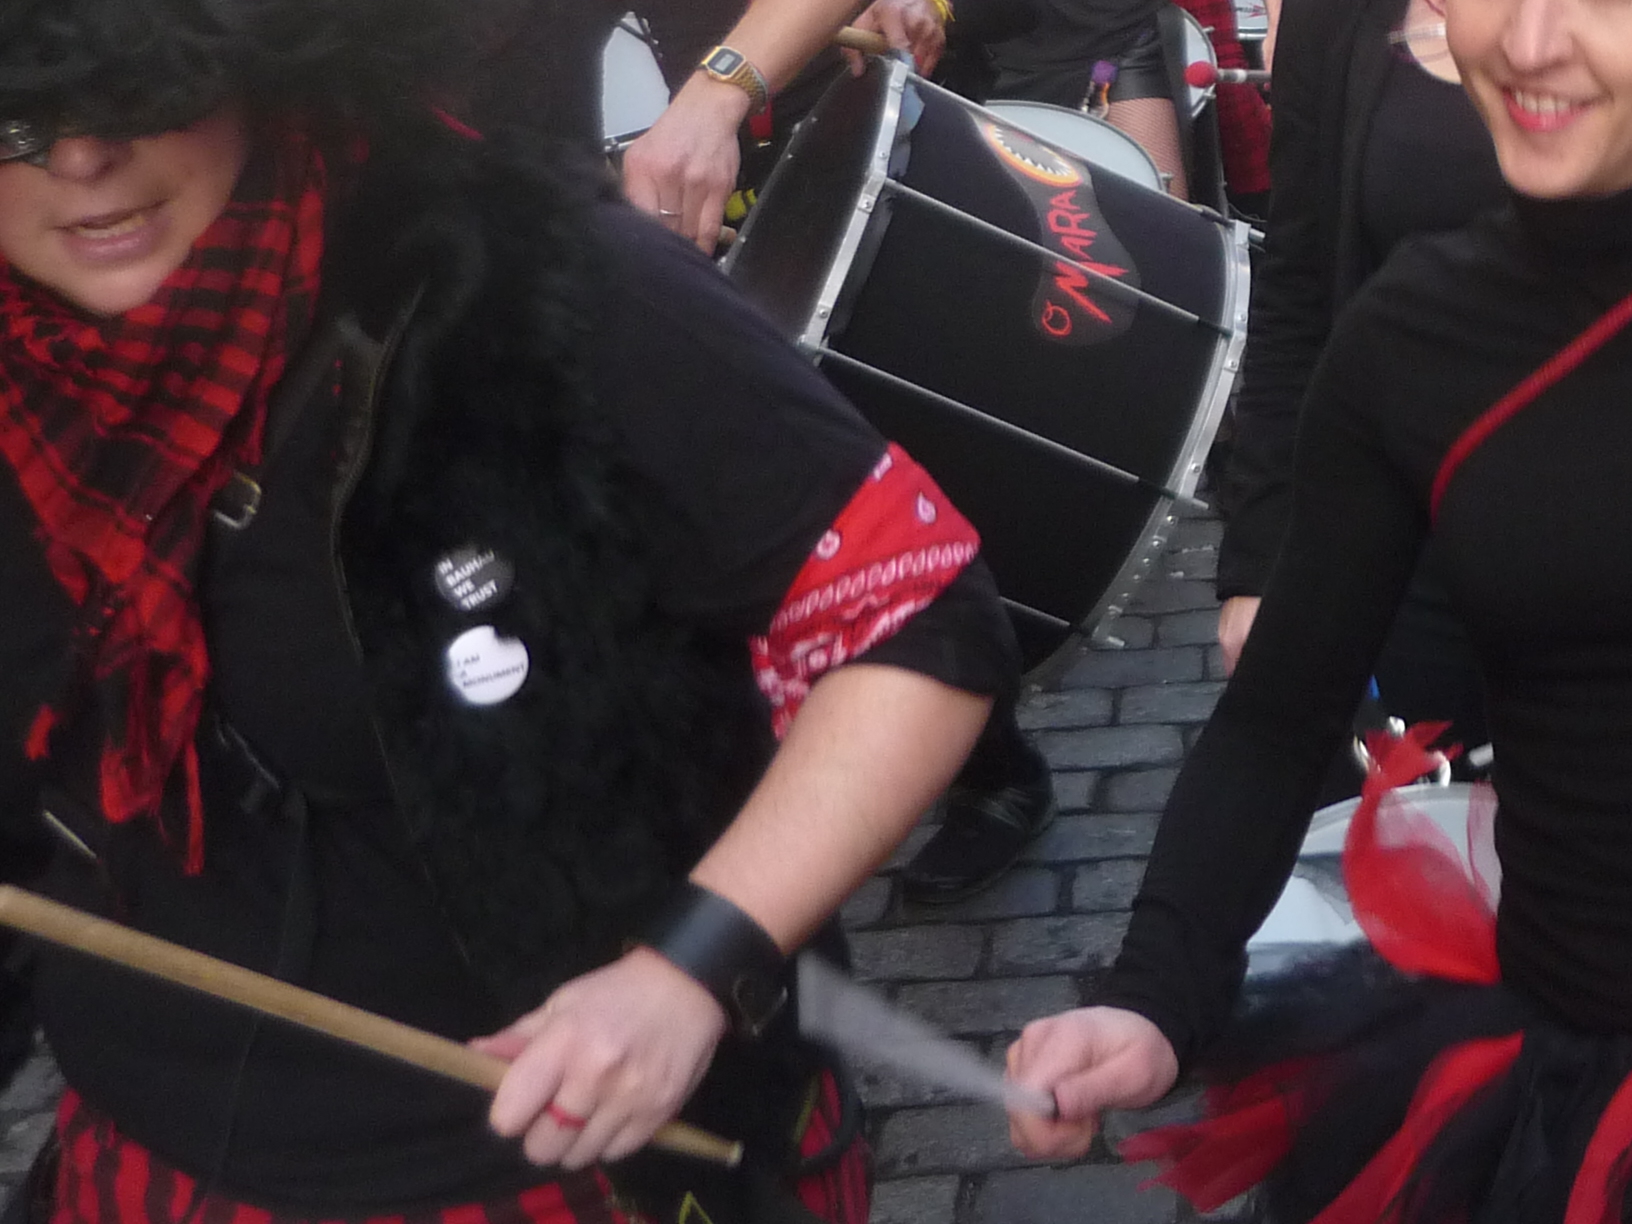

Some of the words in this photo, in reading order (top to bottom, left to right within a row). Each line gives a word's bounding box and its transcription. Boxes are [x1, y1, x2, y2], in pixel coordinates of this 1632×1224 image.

[437, 558, 454, 576] IN
[454, 578, 475, 598] WE
[461, 579, 498, 610] TRUST
[463, 653, 480, 666] AM
